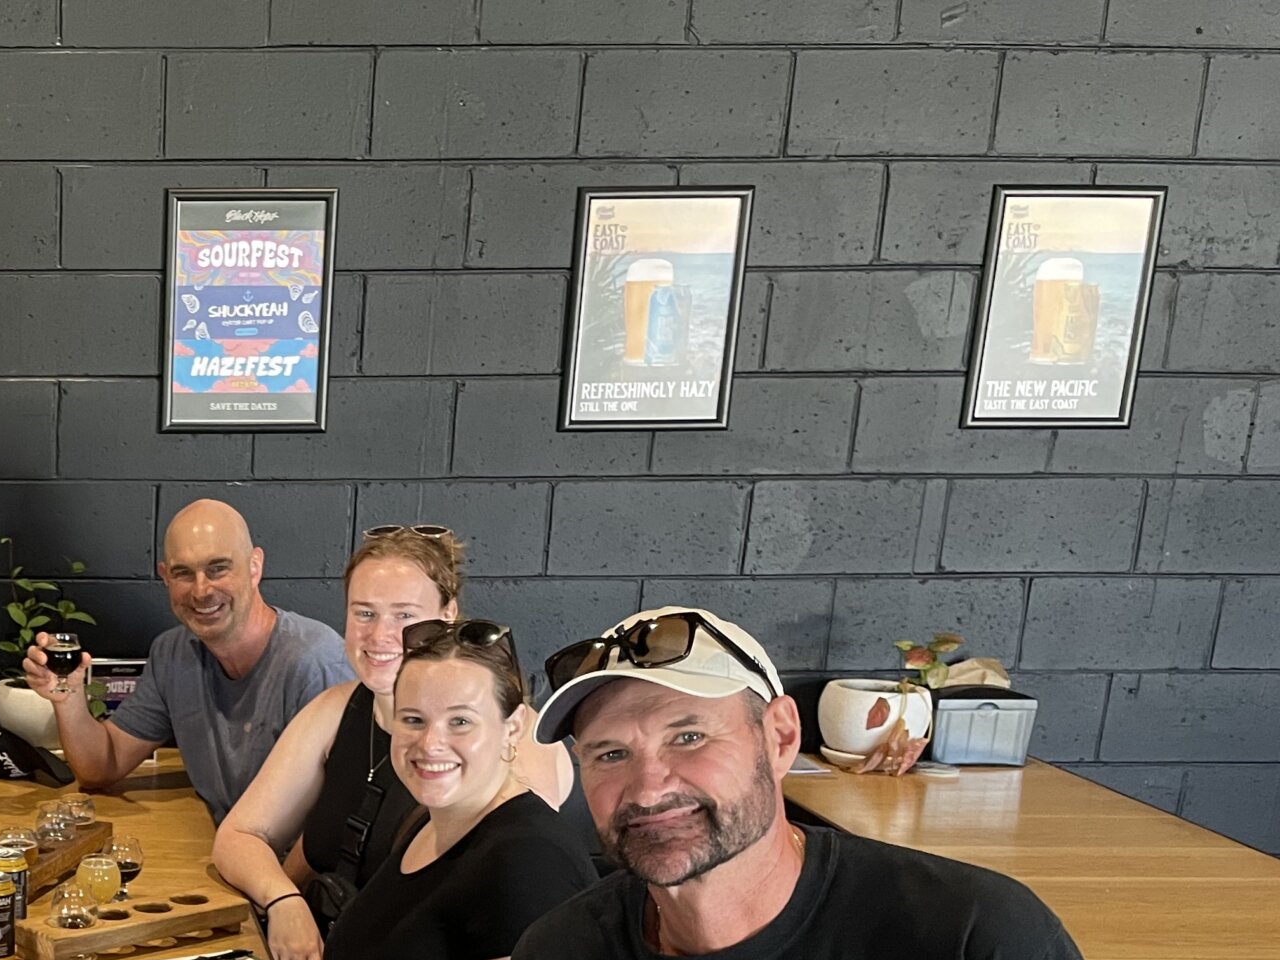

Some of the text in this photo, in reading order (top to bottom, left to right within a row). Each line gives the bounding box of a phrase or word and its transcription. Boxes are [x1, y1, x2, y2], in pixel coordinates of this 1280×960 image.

[225, 209, 253, 223] Black
[593, 224, 620, 238] EAST
[1007, 222, 1033, 236] EAST
[593, 234, 627, 251] COAST
[1006, 233, 1039, 249] COAST
[197, 240, 303, 268] SOURFEST
[208, 302, 289, 318] SHUCKYEAH
[190, 356, 301, 377] HAZEFEST
[582, 380, 716, 399] REFRESHINGLY HAZY
[986, 379, 1099, 397] THE NEW PACIFIC
[209, 403, 277, 411] SAVE THE DATES
[579, 400, 638, 412] STILL THE ONE
[984, 399, 1080, 410] TASTE THE EAST COAST
